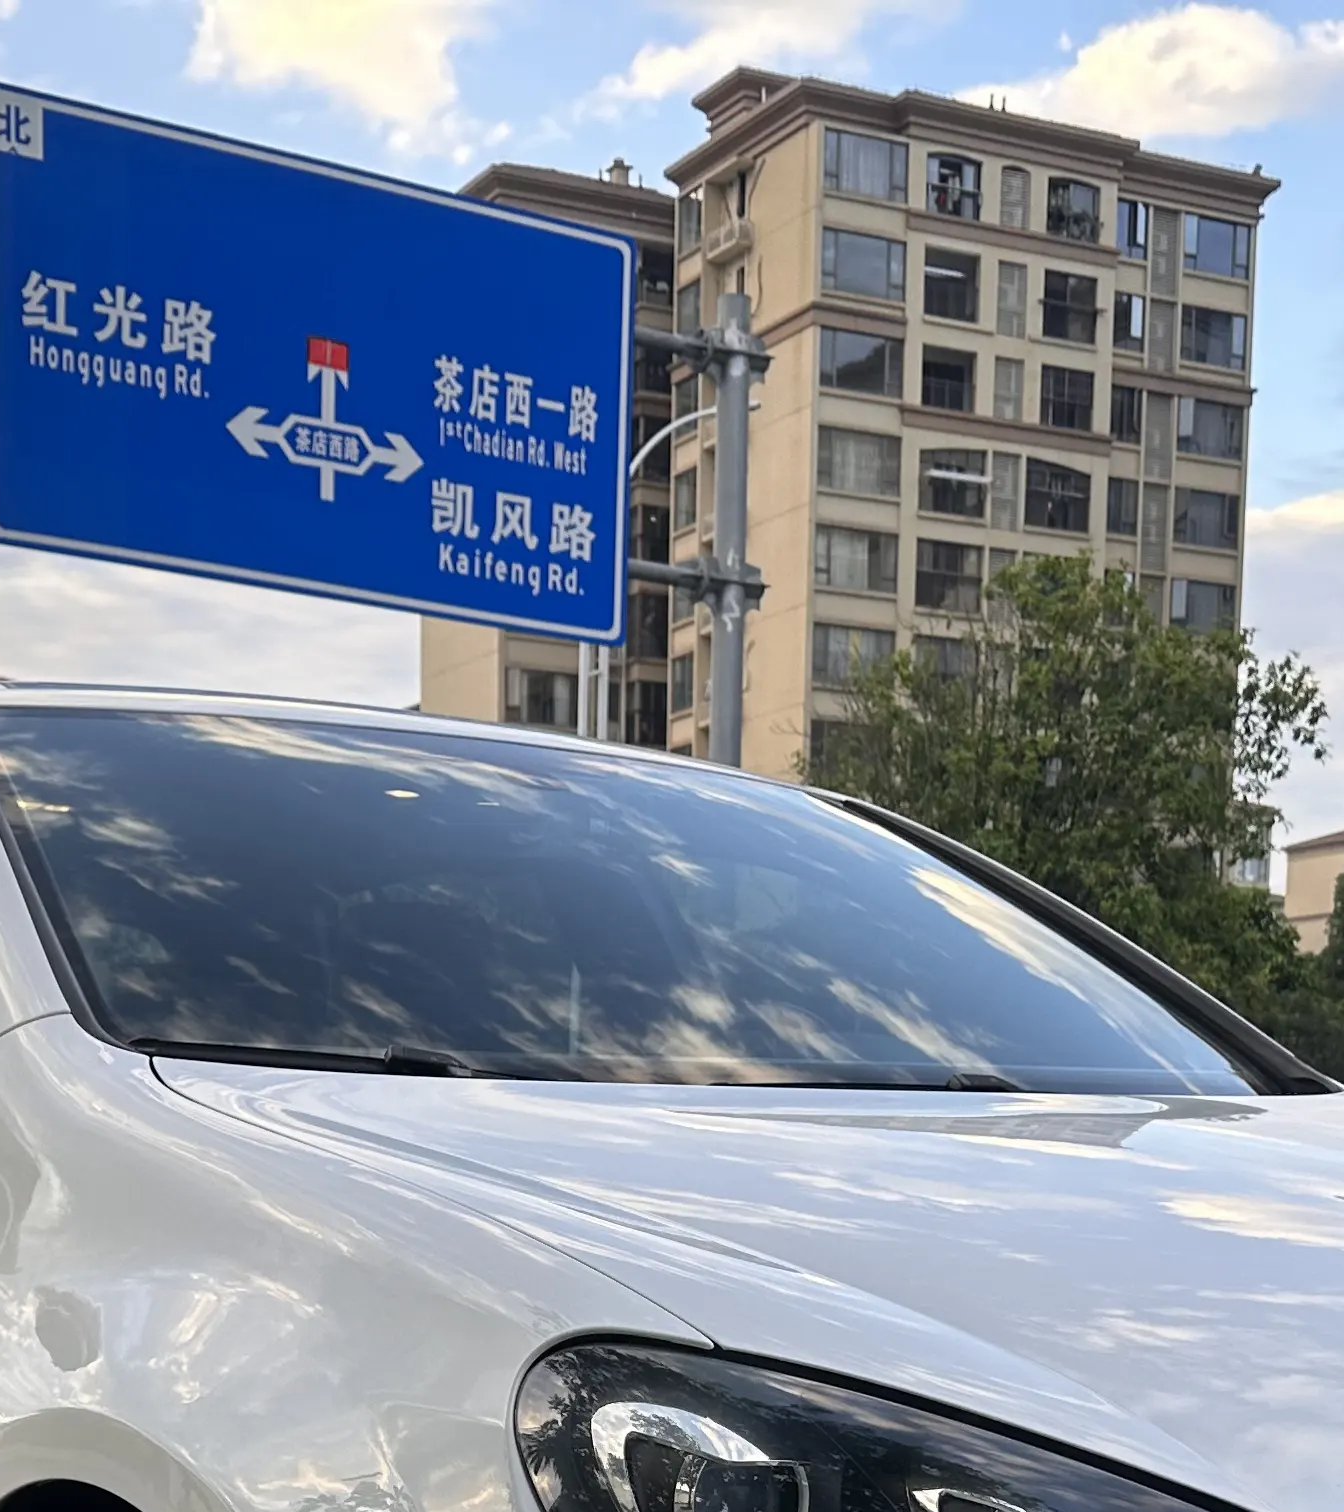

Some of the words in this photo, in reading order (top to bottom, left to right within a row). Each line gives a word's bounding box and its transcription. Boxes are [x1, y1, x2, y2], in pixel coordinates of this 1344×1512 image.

[22, 270, 217, 365] 红光路
[29, 335, 167, 399] Hongguang
[174, 363, 209, 398] Rd.
[433, 354, 599, 443] 茶店西一路
[528, 435, 550, 468] Rd.
[554, 441, 587, 476] West
[431, 478, 596, 563] 凯风路
[438, 542, 541, 596] Kaifeng
[548, 563, 584, 596] Rd.
